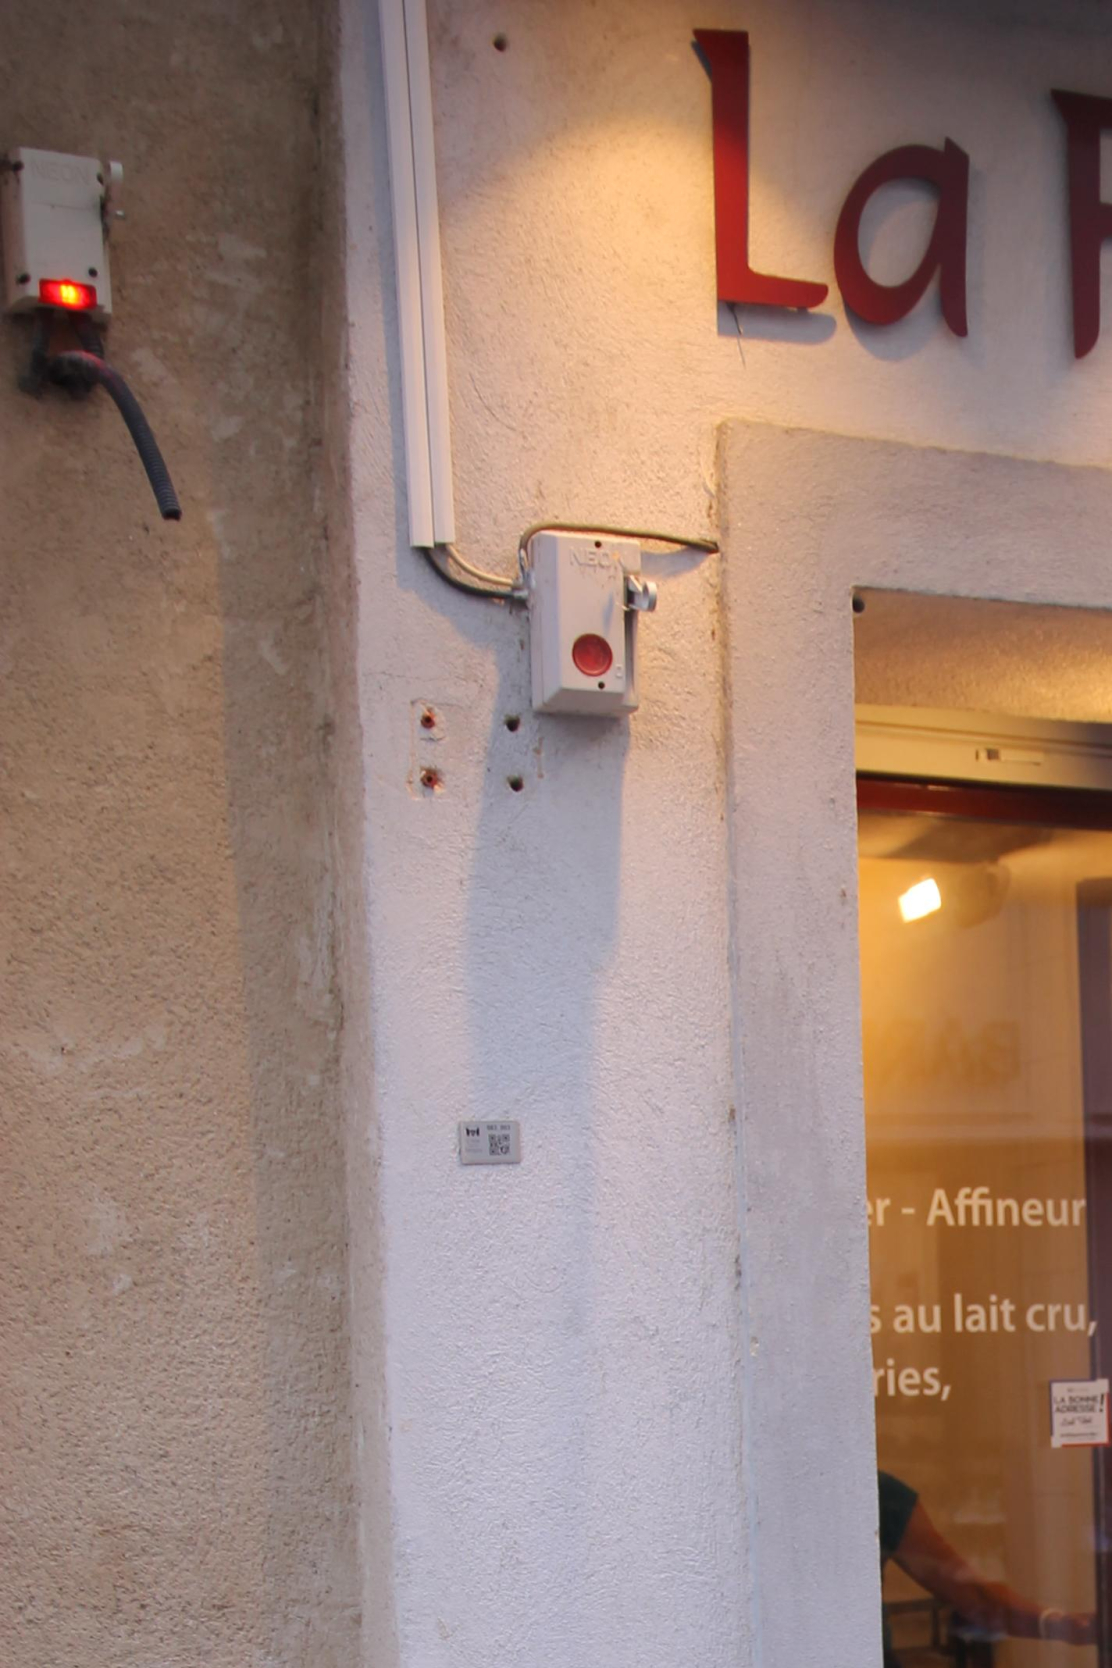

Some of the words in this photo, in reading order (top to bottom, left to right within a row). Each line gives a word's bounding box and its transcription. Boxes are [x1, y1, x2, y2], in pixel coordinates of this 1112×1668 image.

[692, 28, 970, 338] La
[926, 1186, 1087, 1227] Affineur
[893, 1303, 942, 1334] au
[953, 1292, 1016, 1333] lait
[1024, 1302, 1098, 1337] cru,
